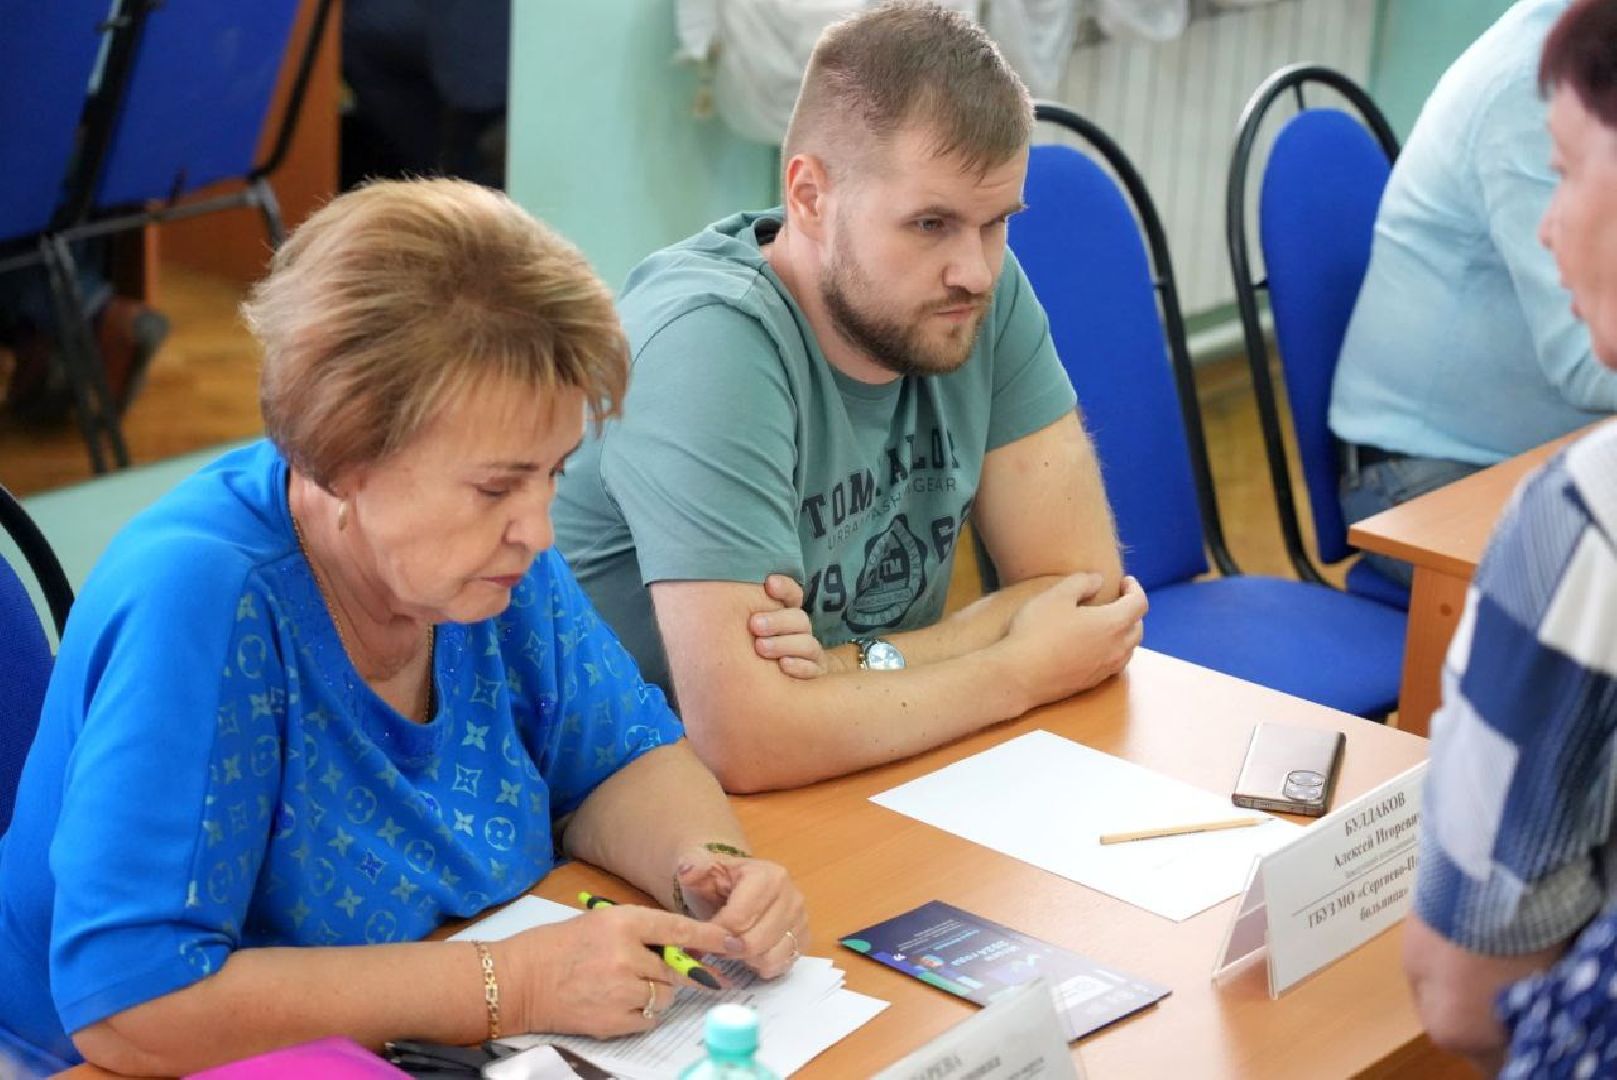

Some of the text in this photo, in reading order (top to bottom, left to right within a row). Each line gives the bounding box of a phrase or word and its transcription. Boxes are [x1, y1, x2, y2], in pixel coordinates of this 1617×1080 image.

[801, 467, 875, 539] TOM
[913, 477, 957, 493] GEAR
[1333, 834, 1375, 870] Алексей
[1375, 812, 1421, 845] Игореви
